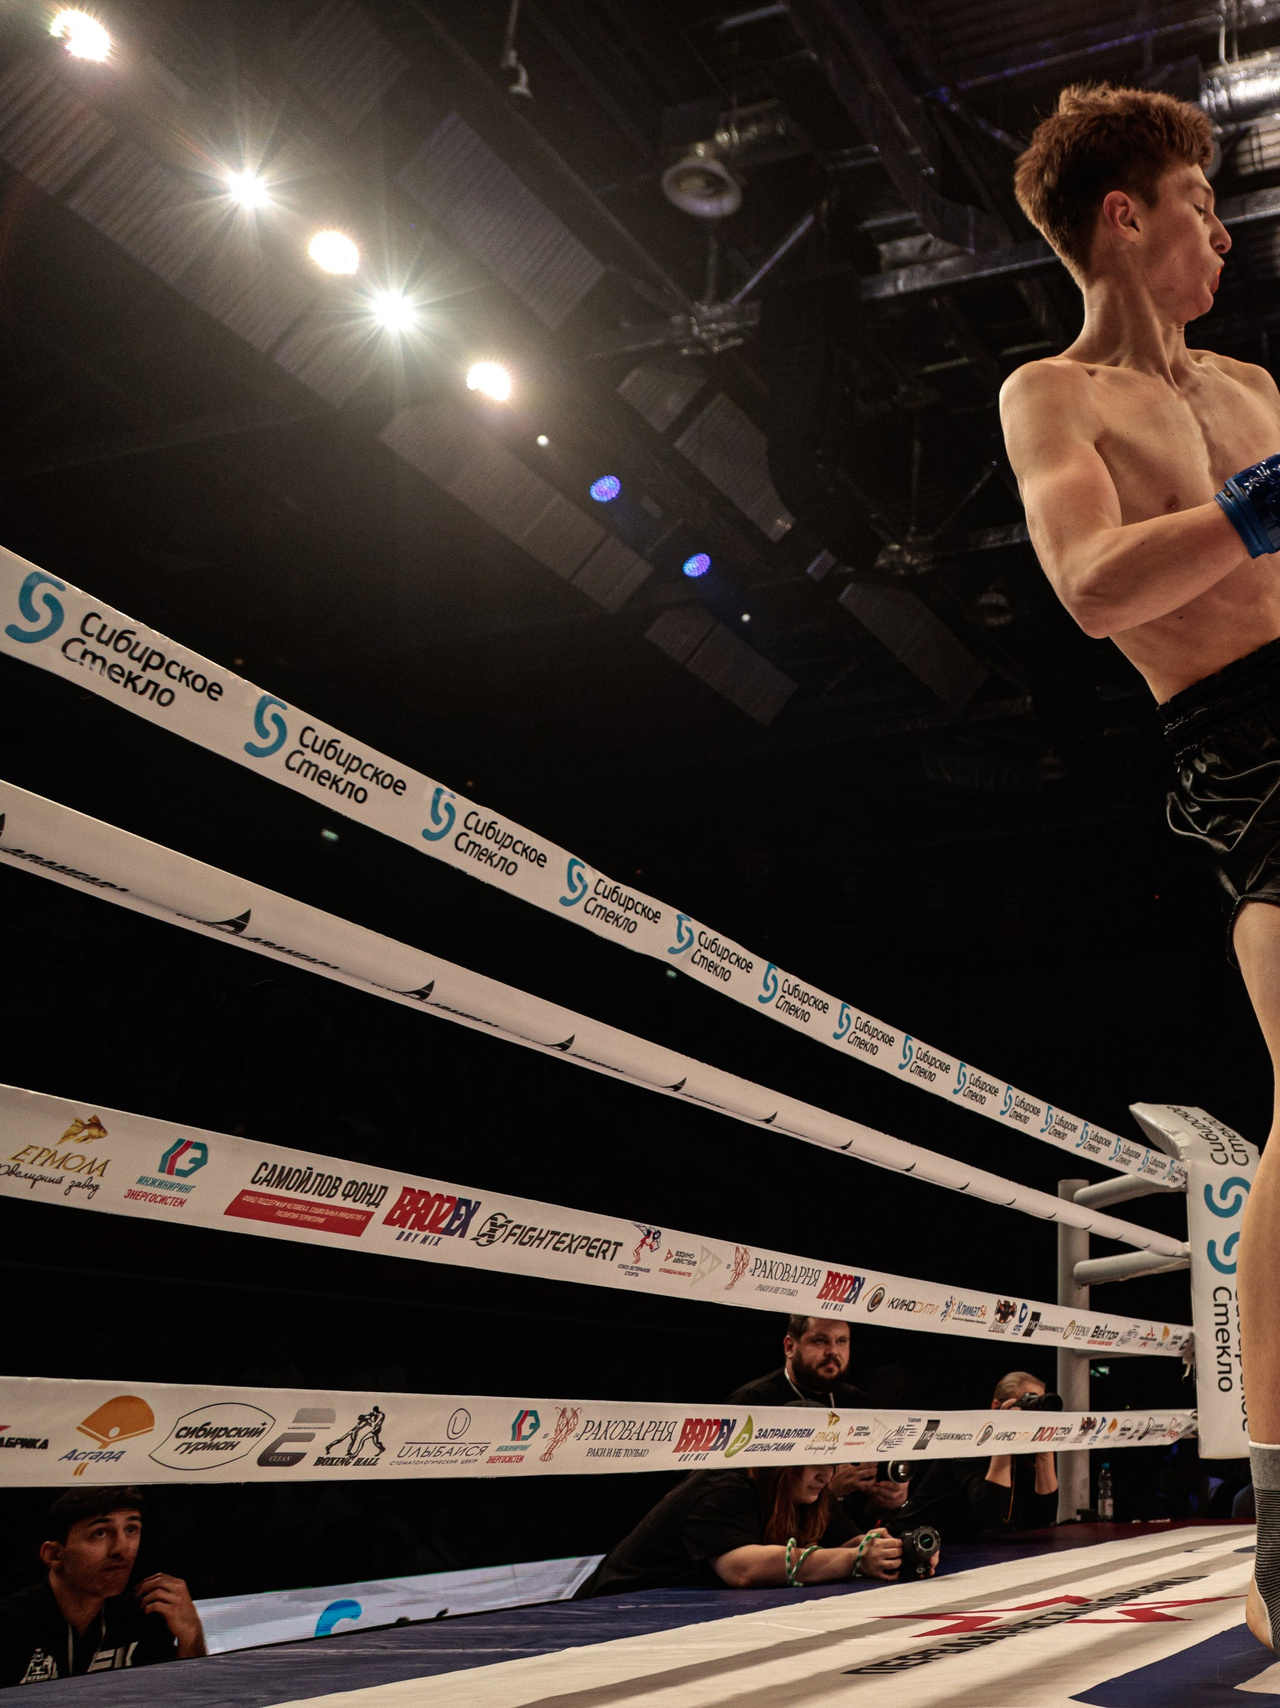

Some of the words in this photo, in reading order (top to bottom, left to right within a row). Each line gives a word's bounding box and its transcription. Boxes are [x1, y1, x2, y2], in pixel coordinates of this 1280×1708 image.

[80, 612, 224, 701] Сибирское
[62, 638, 175, 706] Стекло
[300, 726, 407, 795] Сибирское
[285, 750, 368, 803] Стекло
[464, 811, 547, 867] Сибирское
[455, 833, 517, 876] Стекло
[594, 879, 661, 924] Сибирское
[584, 898, 637, 933] Стекло
[691, 950, 732, 982] Стекло
[698, 931, 753, 974] Сибирское
[775, 996, 810, 1022] Стекло
[782, 979, 829, 1014] Сибирское
[847, 1032, 878, 1055] Стекло
[855, 1017, 894, 1046] Сибирское
[910, 1061, 936, 1082] Стекло
[916, 1047, 950, 1074] Сибирское
[963, 1086, 986, 1105] Стекло
[969, 1073, 999, 1097] Сибирское
[1009, 1107, 1030, 1124] Стекло
[1015, 1096, 1041, 1116] Сибирское
[1167, 1105, 1228, 1165] Сибирское
[64, 1176, 100, 1199] завод
[124, 1189, 187, 1207] ЭНЕРГОСИСТЕМ
[136, 1176, 196, 1194] ИНЖИНИРИНГ
[251, 1162, 342, 1198] САМОЙЛОВ
[341, 1180, 388, 1208] ФОНД
[382, 1186, 481, 1238] BROZEX
[395, 1231, 420, 1245] DRY
[422, 1235, 443, 1246] MIX
[501, 1224, 623, 1261] FIGHTEXPERT
[752, 1257, 821, 1287] РАКОВАРНЯ
[817, 1270, 865, 1304] BROZEX
[1213, 1286, 1233, 1393] Стекло
[175, 1421, 268, 1441] сибирский
[576, 1420, 678, 1441] РАКОВАРНЯ
[672, 1418, 737, 1453] BROZEX
[755, 1428, 815, 1439] ЗАПРАВЛЯЕМ
[58, 1449, 126, 1463] Асгард
[174, 1441, 240, 1454] гурман
[313, 1456, 351, 1466] BOXING
[352, 1457, 380, 1466] HALL
[486, 1455, 525, 1464] ЭНЕРГОСИСТЕМ
[586, 1448, 606, 1457] РАКИ
[613, 1448, 623, 1457] НЕ
[623, 1449, 649, 1457] ТОЛЬКО
[744, 1443, 796, 1452] ДЕНЬГАМИ
